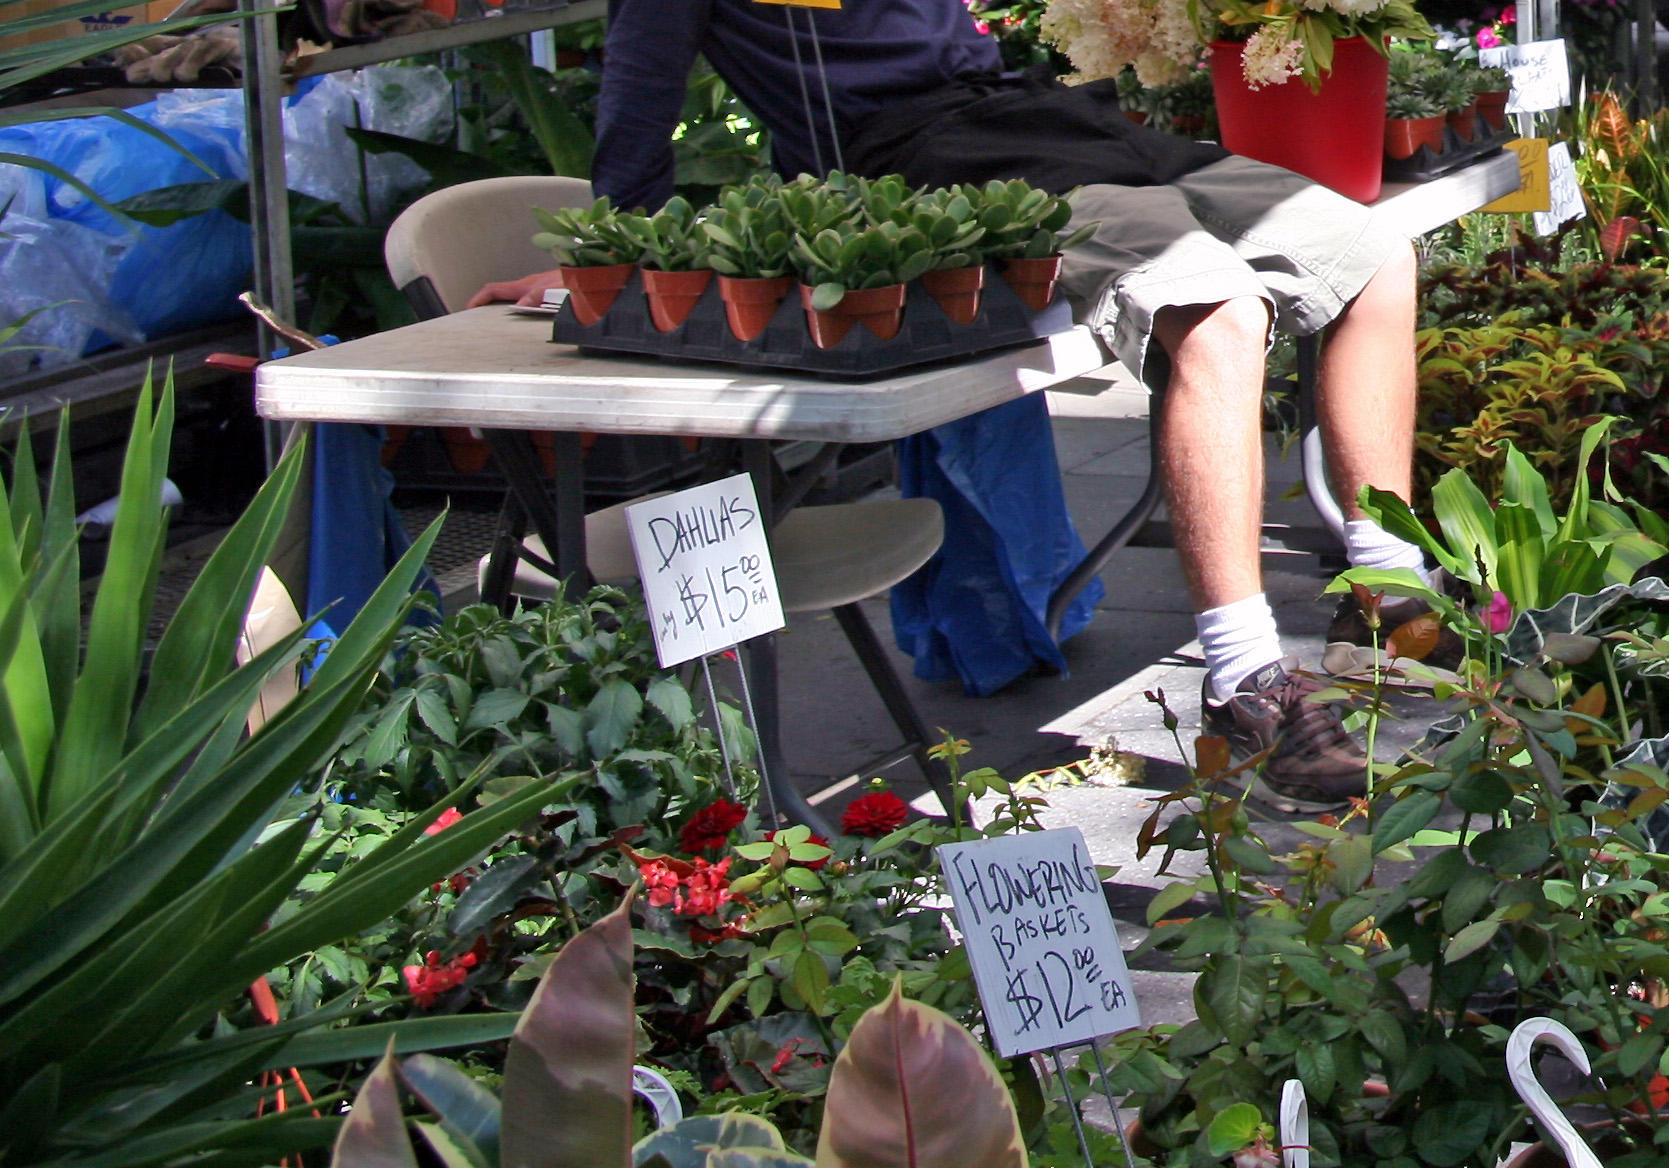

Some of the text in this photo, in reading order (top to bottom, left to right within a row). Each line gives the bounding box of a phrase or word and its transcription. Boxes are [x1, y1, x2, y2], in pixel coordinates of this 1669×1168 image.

[648, 495, 756, 574] DAHLIAS
[752, 585, 769, 605] EA
[952, 843, 1099, 926] FLOWERING
[991, 904, 1091, 973] BASKETS
[1100, 979, 1127, 1012] EA
